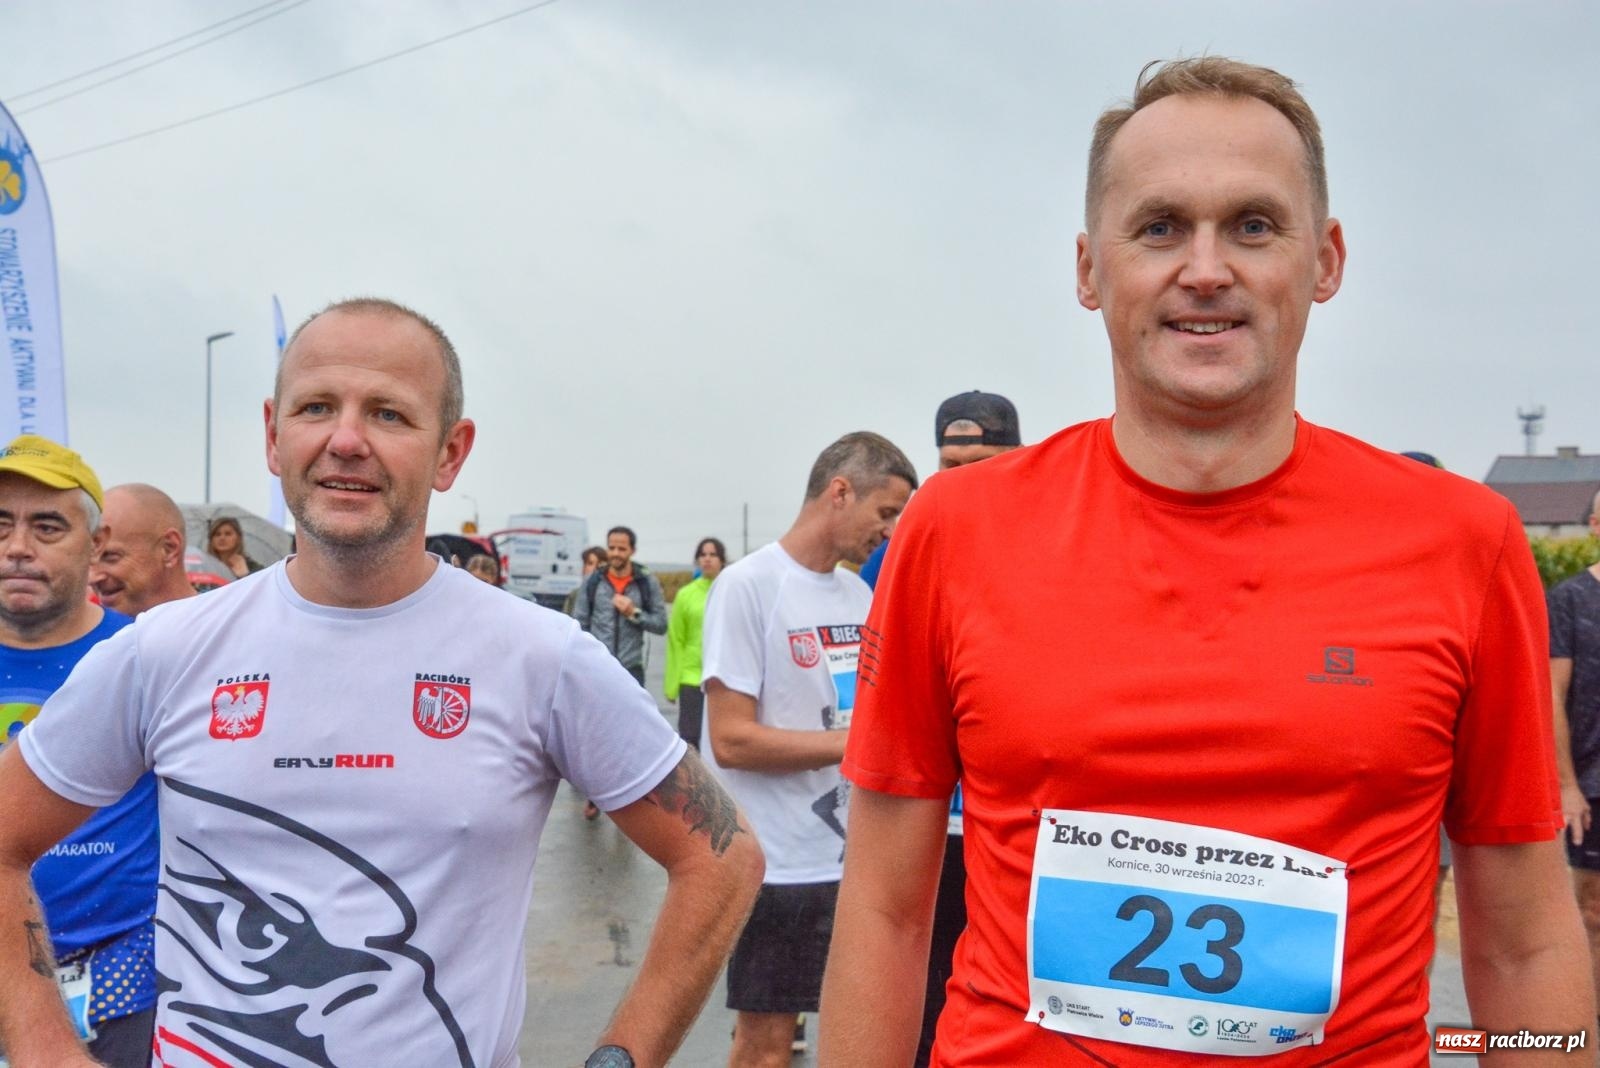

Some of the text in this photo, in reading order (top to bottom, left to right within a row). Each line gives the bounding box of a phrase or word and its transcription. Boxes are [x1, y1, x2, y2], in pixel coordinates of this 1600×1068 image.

[10, 338, 36, 390] AKTYWNI
[18, 396, 36, 419] DLA
[819, 628, 832, 644] X
[217, 673, 270, 685] POLSKA
[415, 673, 471, 685] RACIBÓRZ
[43, 841, 115, 857] MARATON
[1052, 824, 1329, 879] Eko Cross przez Las
[1107, 857, 1265, 887] Kornice, 30 września 2023 r.
[1108, 894, 1245, 994] 23
[61, 973, 82, 984] Las
